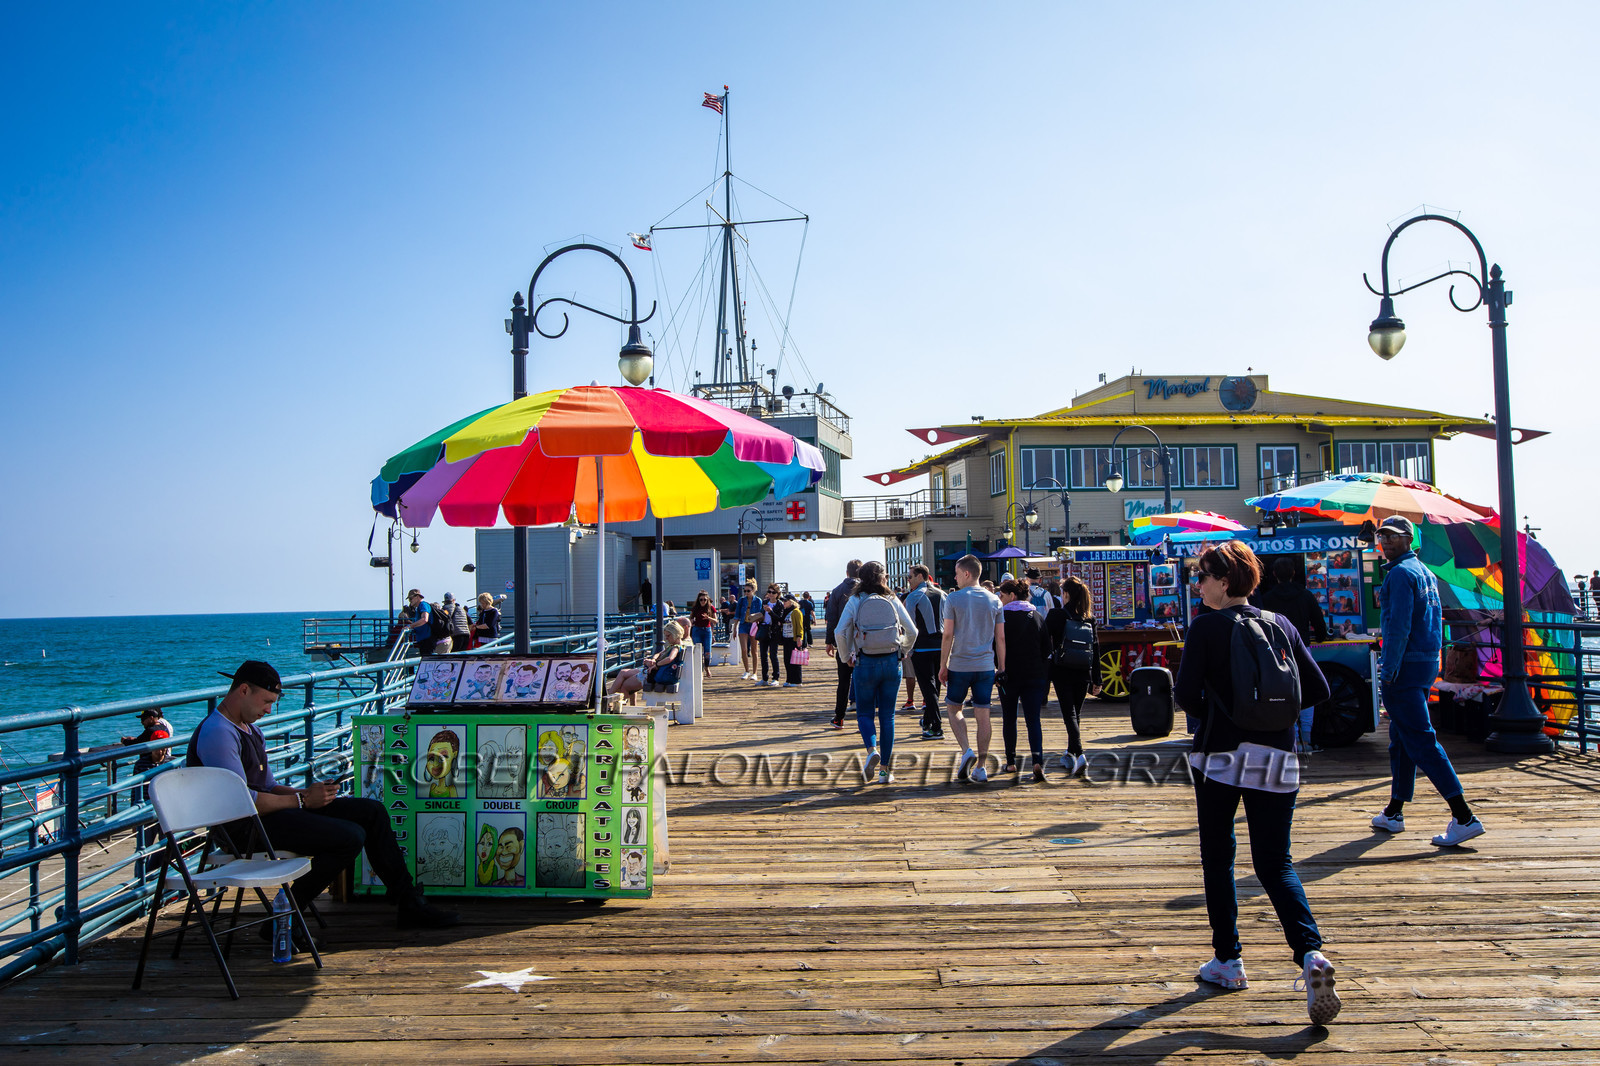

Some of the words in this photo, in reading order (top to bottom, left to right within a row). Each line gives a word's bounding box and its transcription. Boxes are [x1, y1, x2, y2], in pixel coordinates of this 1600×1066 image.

[1124, 500, 1183, 519] Mariaol
[1246, 539, 1295, 554] OTOS
[1300, 537, 1322, 551] IN
[1089, 551, 1101, 561] LA
[1101, 550, 1127, 561] BEACH
[1128, 550, 1148, 560] KITE
[424, 801, 461, 809] SINGLE
[483, 801, 521, 810] DOUBLE
[545, 801, 579, 810] GROUP
[592, 723, 614, 890] CARICATURES
